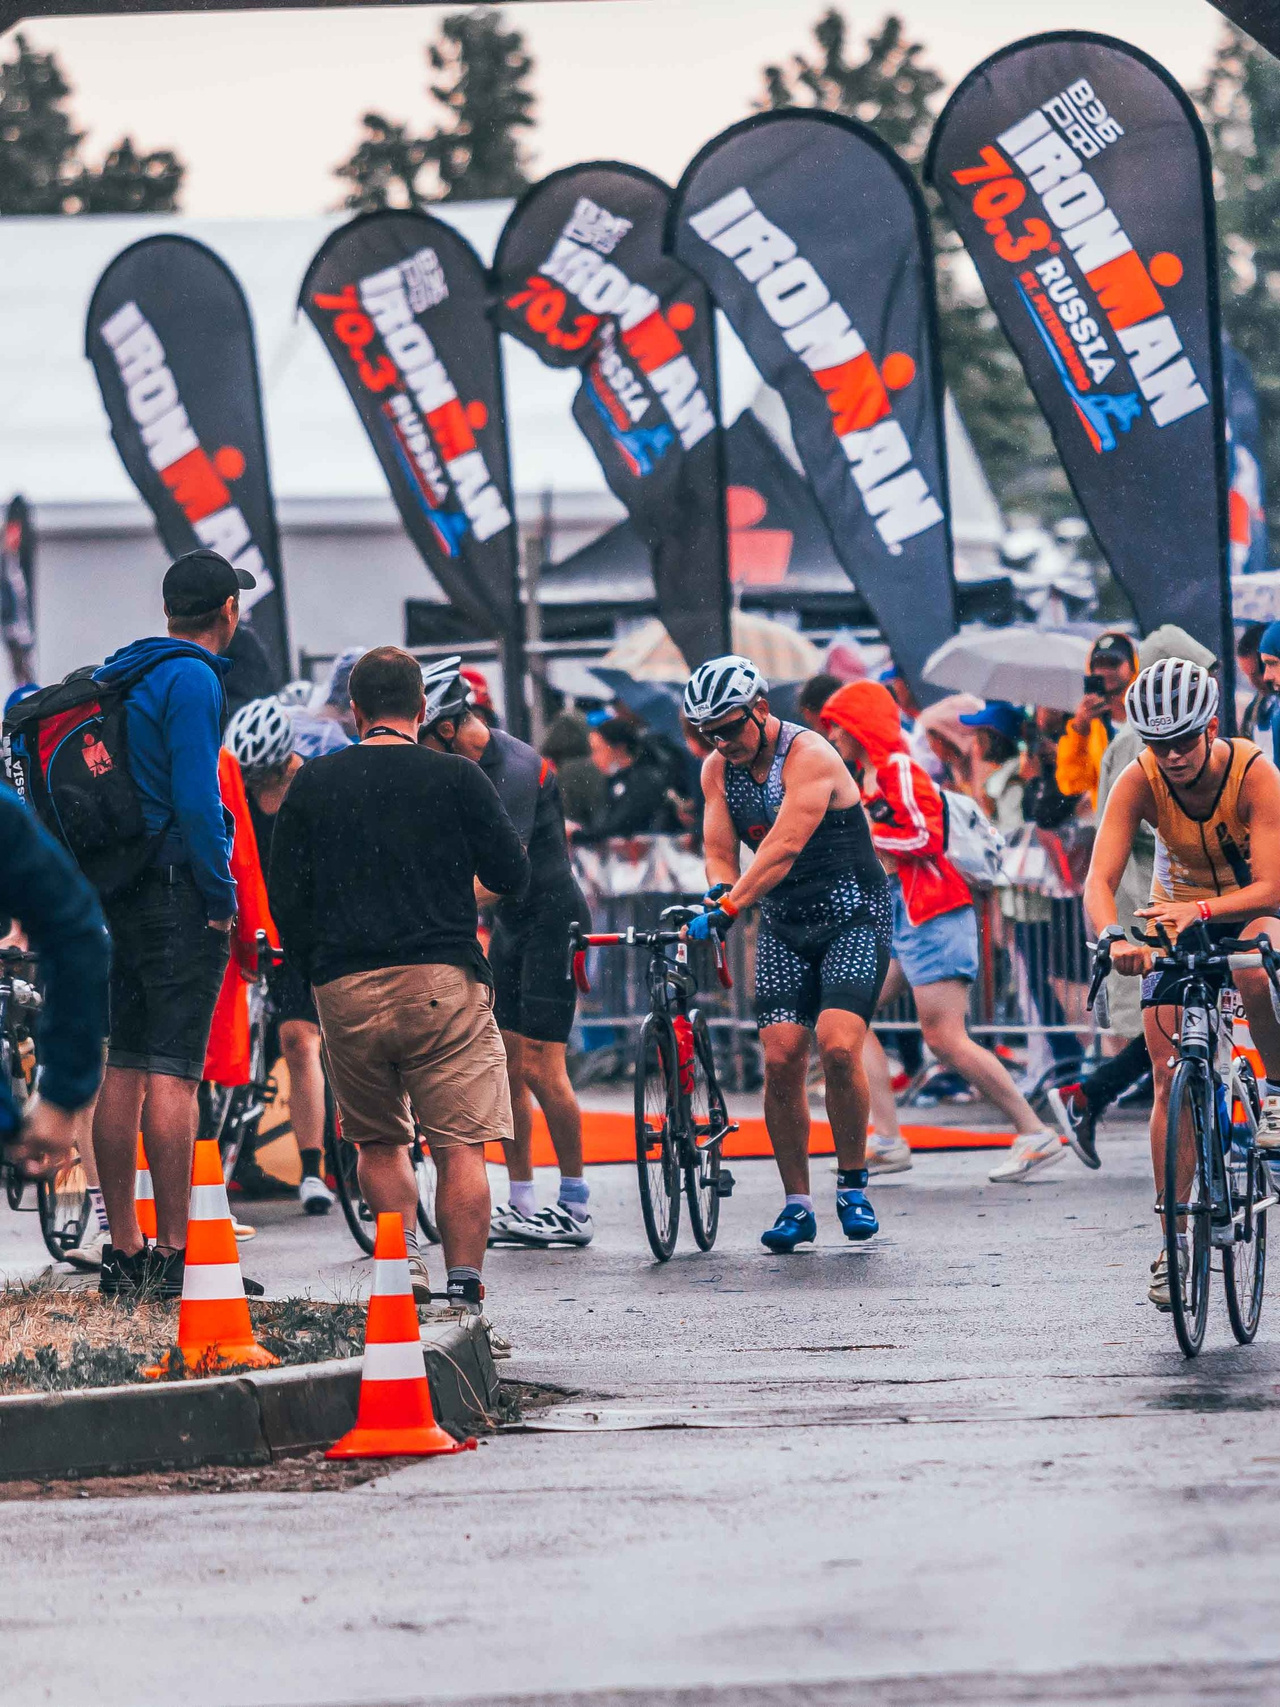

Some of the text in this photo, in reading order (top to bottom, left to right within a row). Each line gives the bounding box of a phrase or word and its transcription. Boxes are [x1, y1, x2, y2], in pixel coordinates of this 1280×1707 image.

[951, 145, 1054, 263] 70.3
[996, 109, 1209, 429] IRONMAN
[1035, 256, 1116, 385] RUSSIA
[312, 284, 399, 394] 70.3
[538, 237, 717, 451] IRONMAN
[688, 186, 945, 547] IRONMAN
[359, 265, 512, 543] IRONMAN
[388, 393, 450, 504] RUSSIA
[12, 760, 26, 806] USSIA
